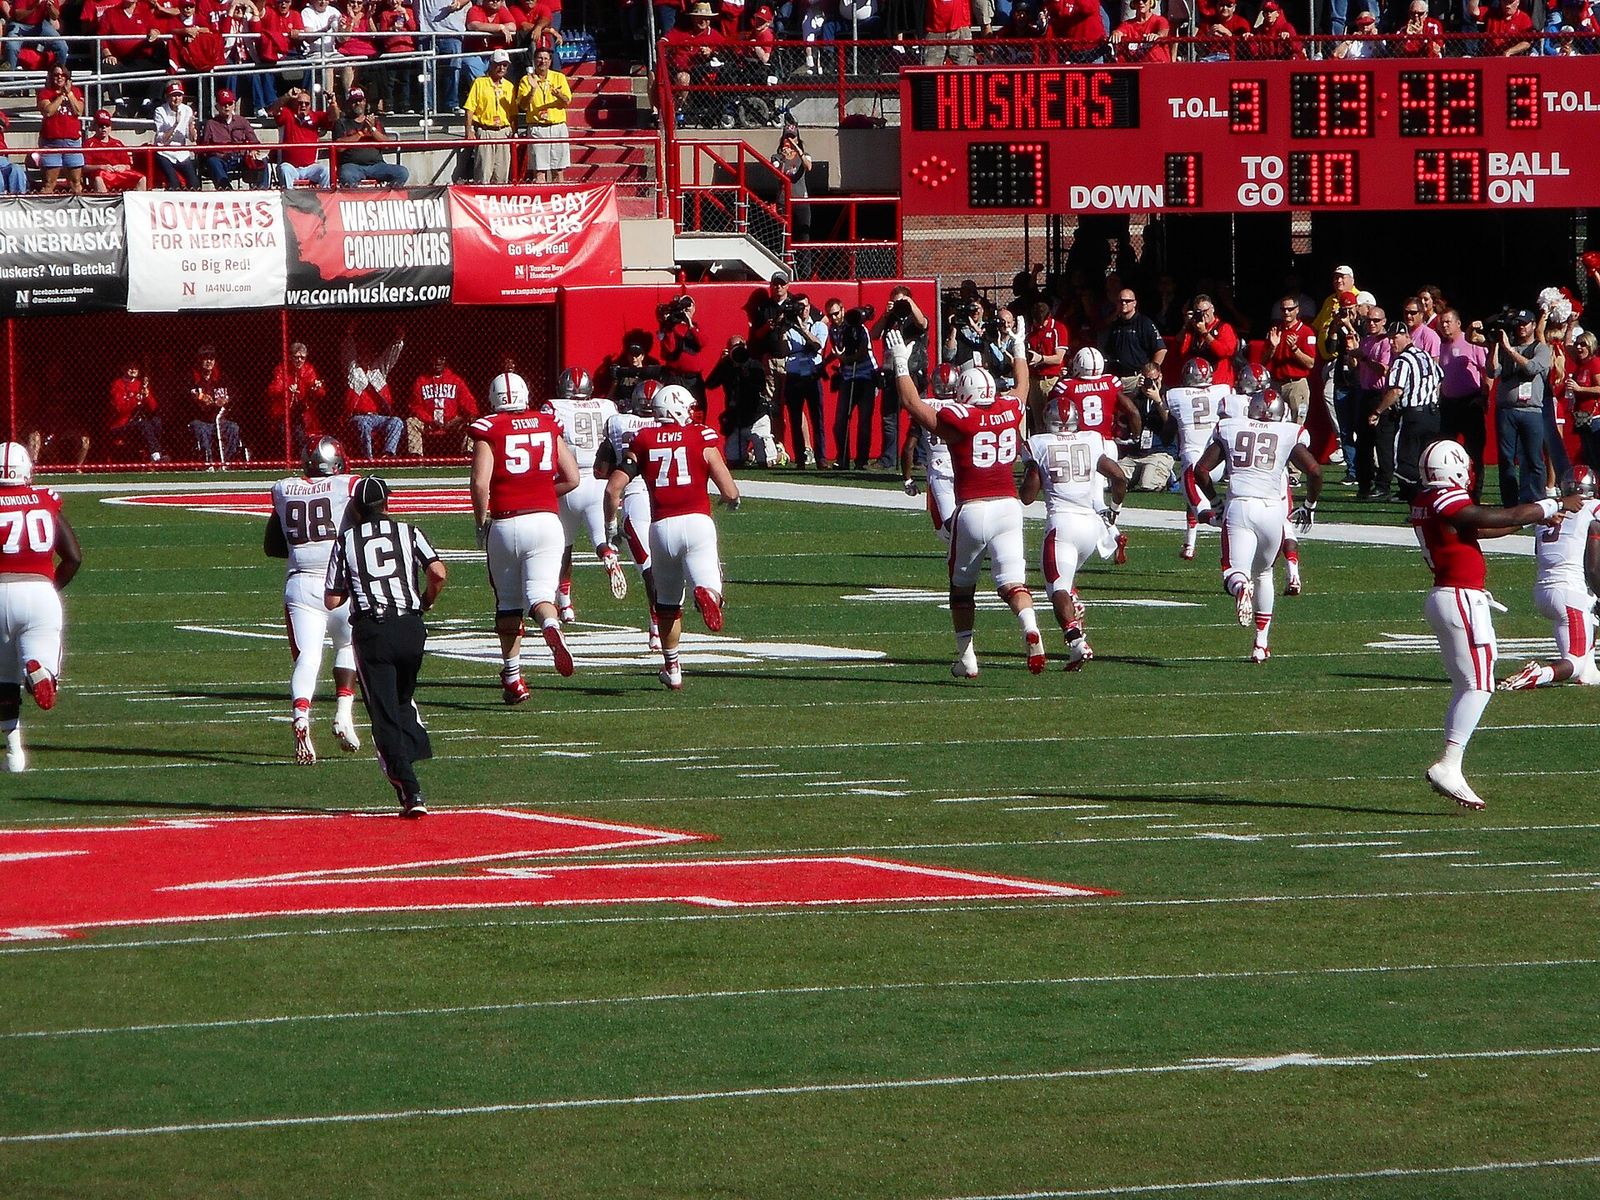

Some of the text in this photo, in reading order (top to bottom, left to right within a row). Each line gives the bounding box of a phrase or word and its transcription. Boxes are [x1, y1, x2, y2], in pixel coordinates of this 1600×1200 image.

[937, 73, 1112, 130] HUSKERS
[1168, 97, 1228, 117] T.O.L.
[1232, 82, 1259, 131] 3
[1510, 77, 1538, 127] 3
[1241, 156, 1284, 179] TO
[1488, 152, 1570, 176] BALL
[1311, 152, 1352, 203] 10
[1418, 152, 1479, 201] 47
[475, 192, 589, 214] TAMPA BAY
[1070, 185, 1164, 209] DOWN
[1237, 183, 1285, 207] GO
[1488, 179, 1535, 203] ON
[149, 201, 274, 230] IOWANS
[339, 197, 447, 231] WASHINGTON
[489, 214, 583, 235] HUSKERS
[24, 231, 122, 254] NEBRASKA
[152, 232, 277, 250] FOR NEBRASKA
[344, 232, 451, 269] CORNHUSKERS
[508, 242, 569, 258] Go Big Red!
[48, 264, 70, 277] You
[73, 262, 116, 276] Betcha!
[181, 259, 251, 274] Go Big Red!
[16, 290, 29, 303] N
[182, 282, 252, 296] N IA4NU.com
[287, 282, 451, 305] wacornhuskers.com
[1074, 382, 1110, 394] ABDULLAH
[1082, 395, 1103, 427] 8
[1192, 396, 1212, 430] 2
[511, 418, 539, 430] STERUP
[575, 412, 605, 450] 91
[656, 432, 683, 443] LEWIS
[973, 427, 1017, 468] 68
[505, 432, 553, 474] 57
[1232, 431, 1279, 471] 93
[649, 446, 692, 487] 71
[1047, 443, 1092, 484] 50
[285, 481, 332, 496] STEPHENSON
[0, 510, 54, 553] 70
[285, 497, 338, 545] 98
[363, 536, 397, 578] C
